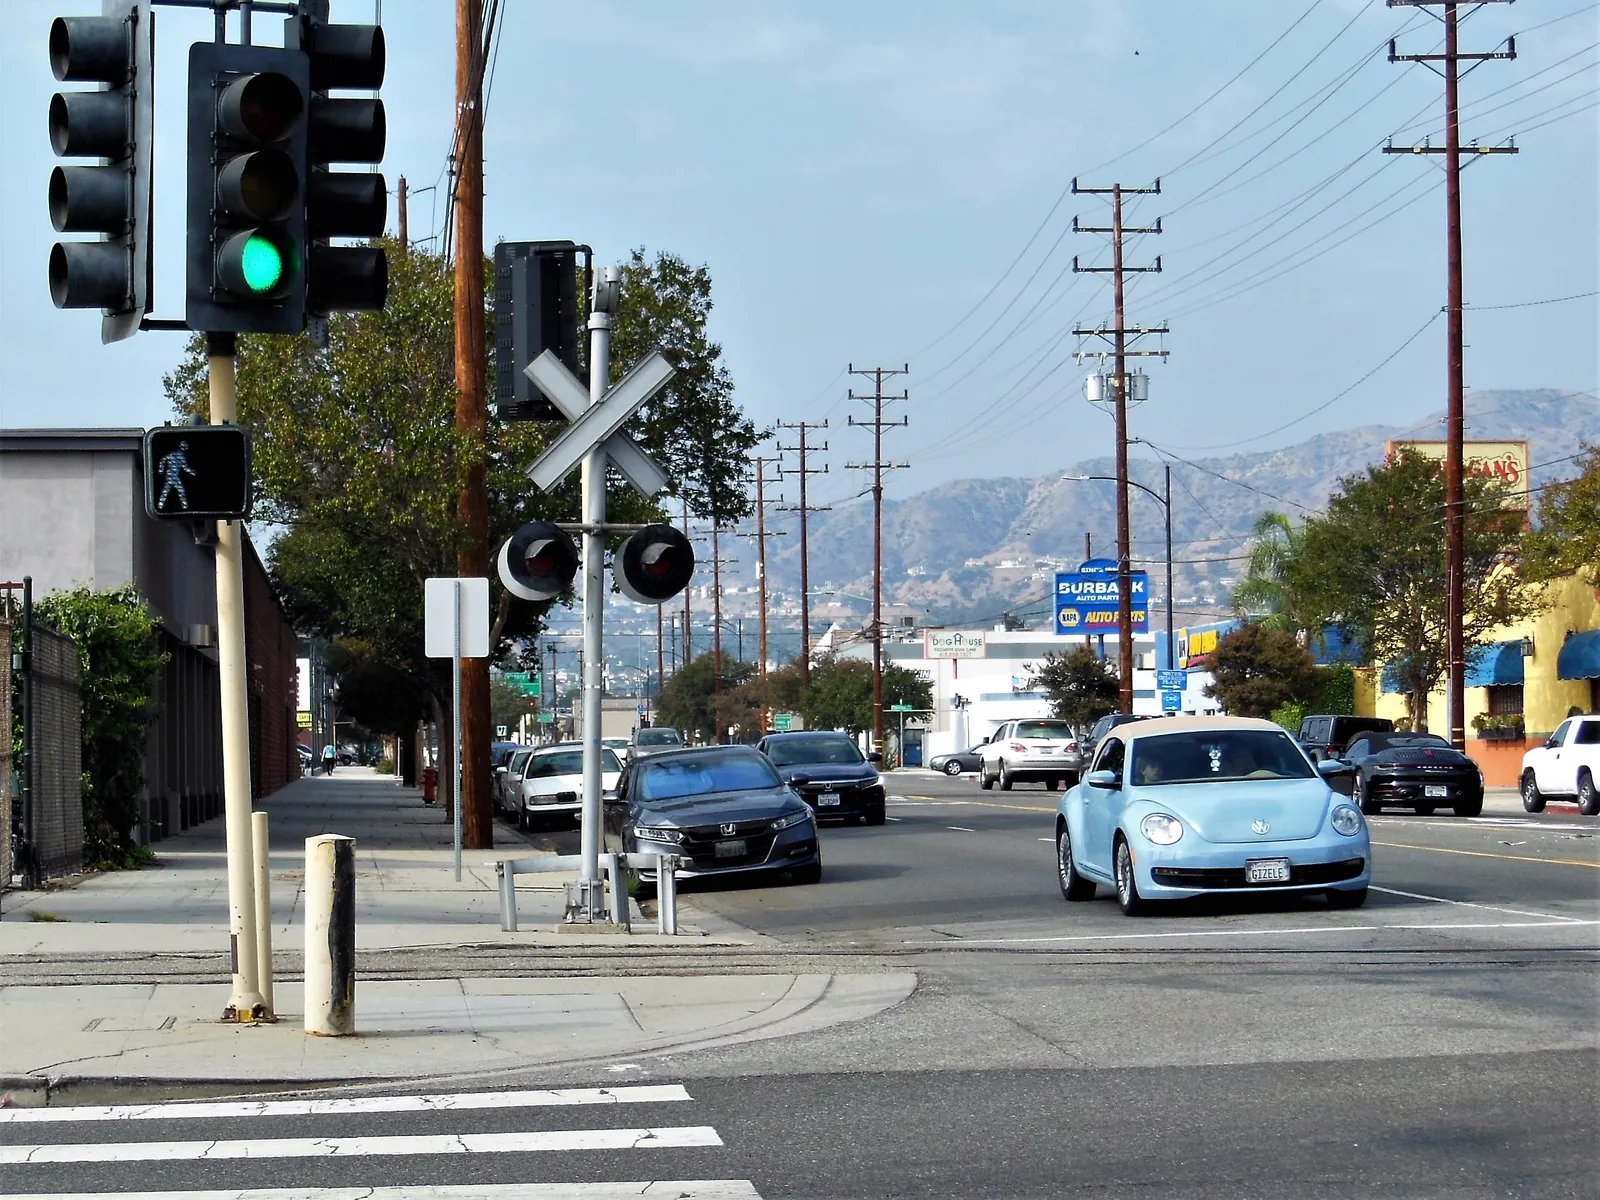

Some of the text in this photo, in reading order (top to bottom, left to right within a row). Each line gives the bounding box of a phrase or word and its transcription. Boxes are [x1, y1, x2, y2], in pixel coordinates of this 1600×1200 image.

[1058, 582, 1144, 594] BURBAK
[1061, 613, 1077, 622] NAPA
[1085, 611, 1113, 623] AUTO
[932, 638, 952, 646] DOG
[1251, 867, 1284, 881] GIZELE
